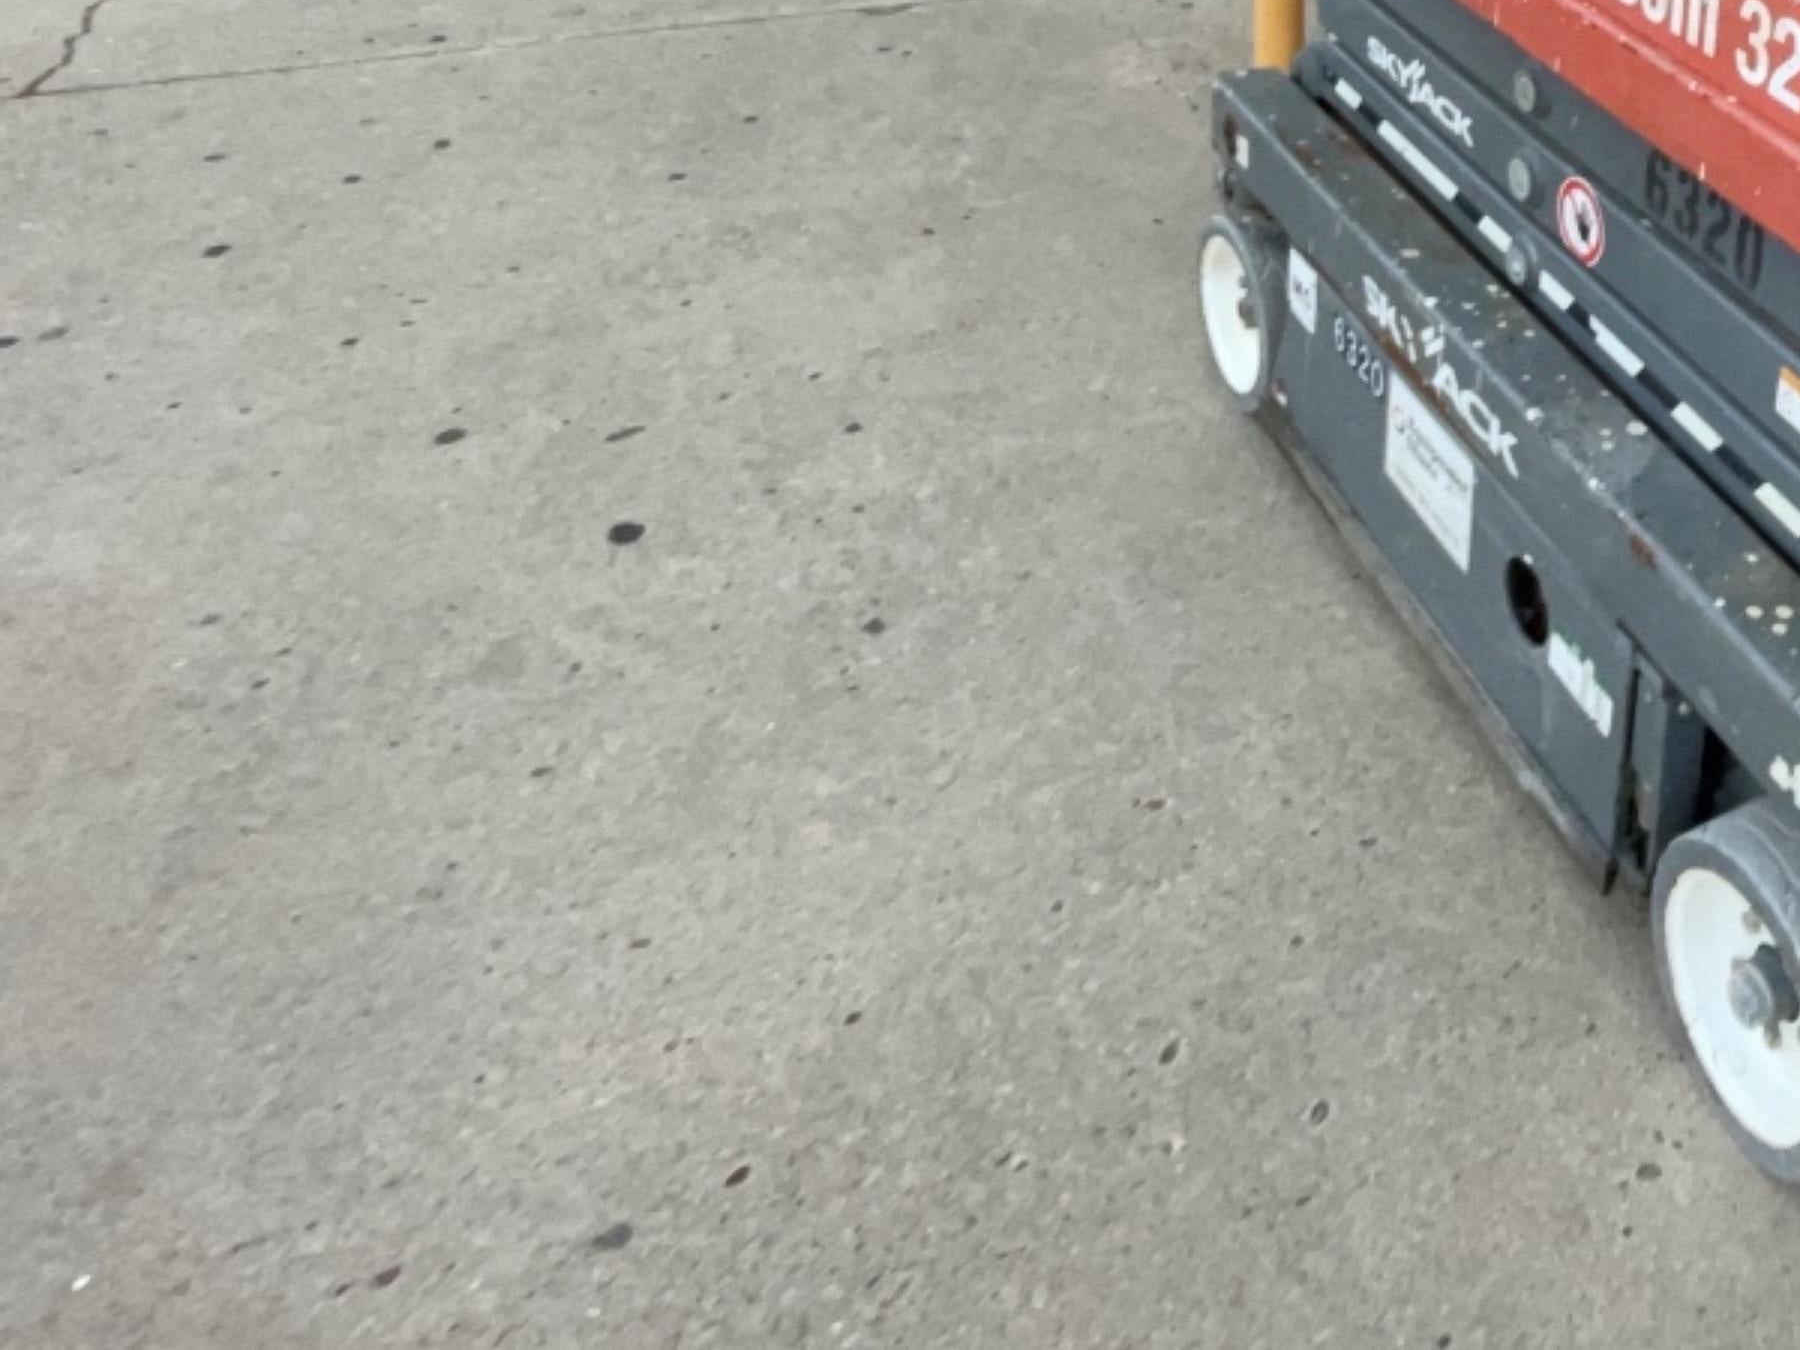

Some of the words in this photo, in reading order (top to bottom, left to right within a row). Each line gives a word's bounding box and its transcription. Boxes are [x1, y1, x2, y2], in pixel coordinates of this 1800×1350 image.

[1366, 35, 1475, 148] SKYJACK
[1645, 150, 1765, 290] 6320
[1333, 316, 1385, 398] 6320
